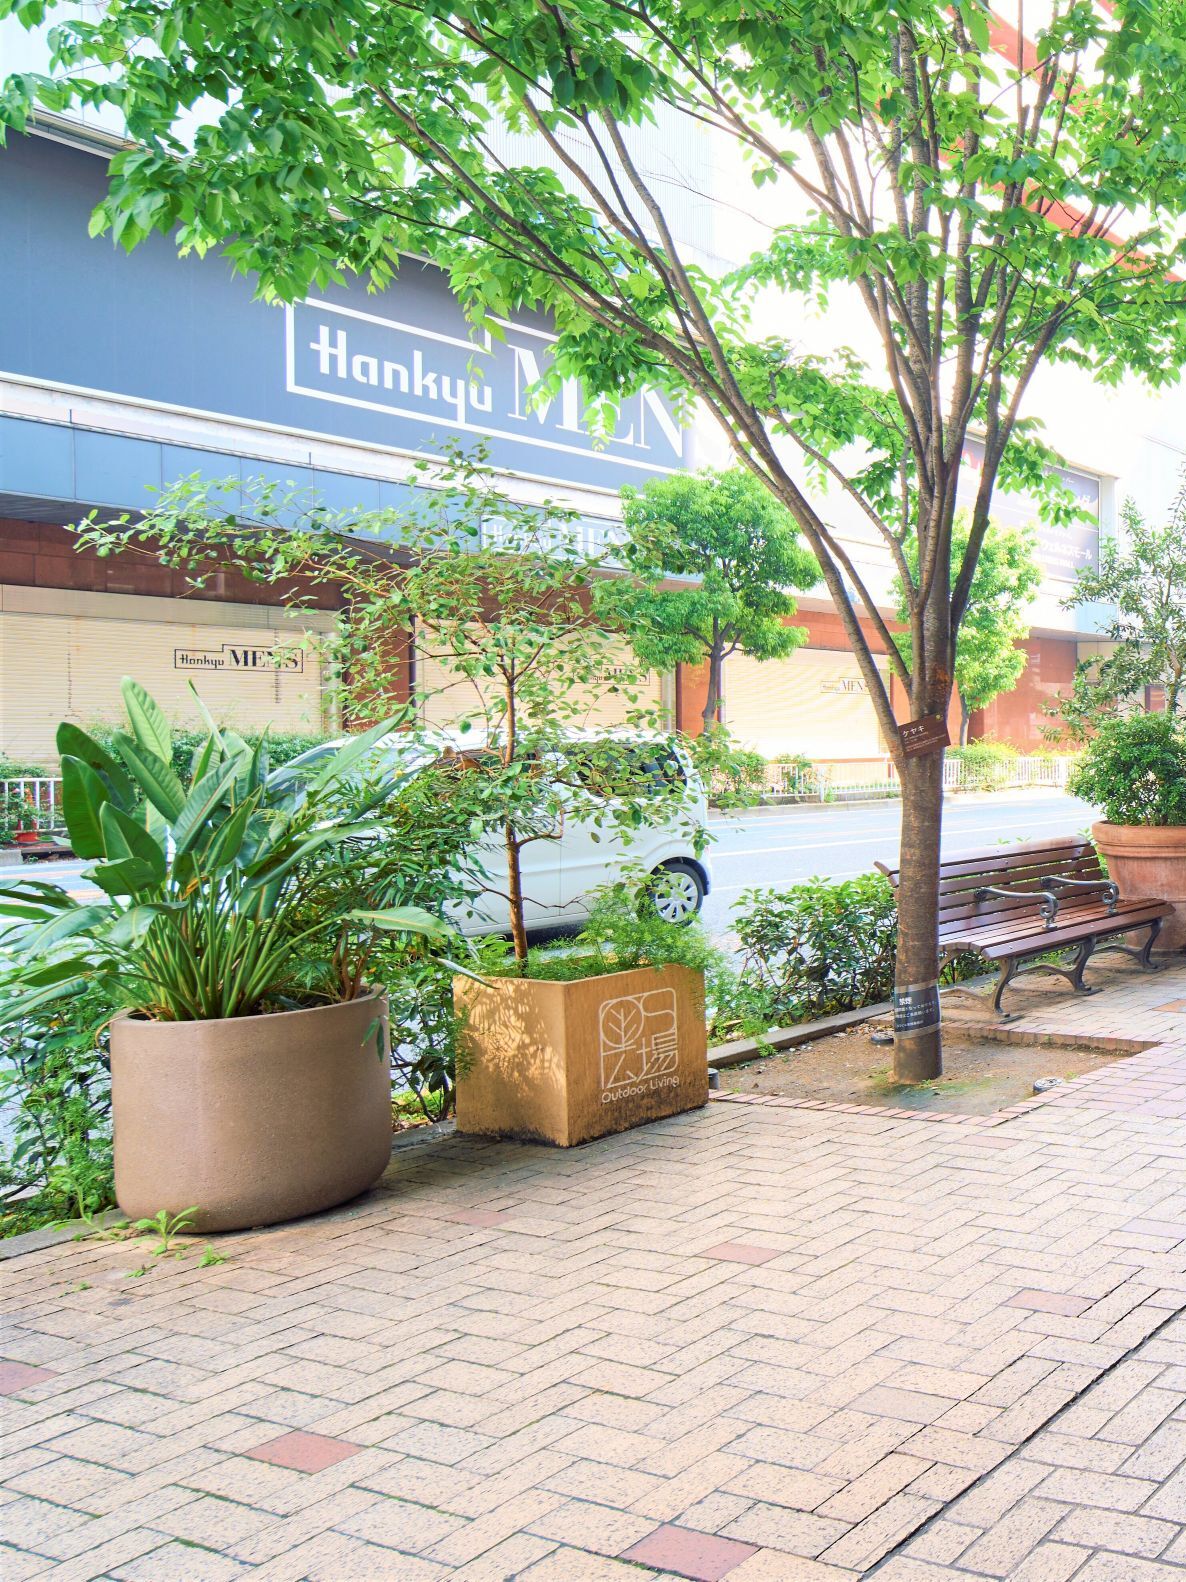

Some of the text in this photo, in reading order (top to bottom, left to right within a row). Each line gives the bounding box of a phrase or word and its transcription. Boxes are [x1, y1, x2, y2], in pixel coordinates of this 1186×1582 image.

[309, 324, 493, 424] Hankyu
[180, 653, 225, 668] Hankyu
[902, 725, 925, 738] ケヤキ
[602, 1075, 680, 1103] Outdoor Living
